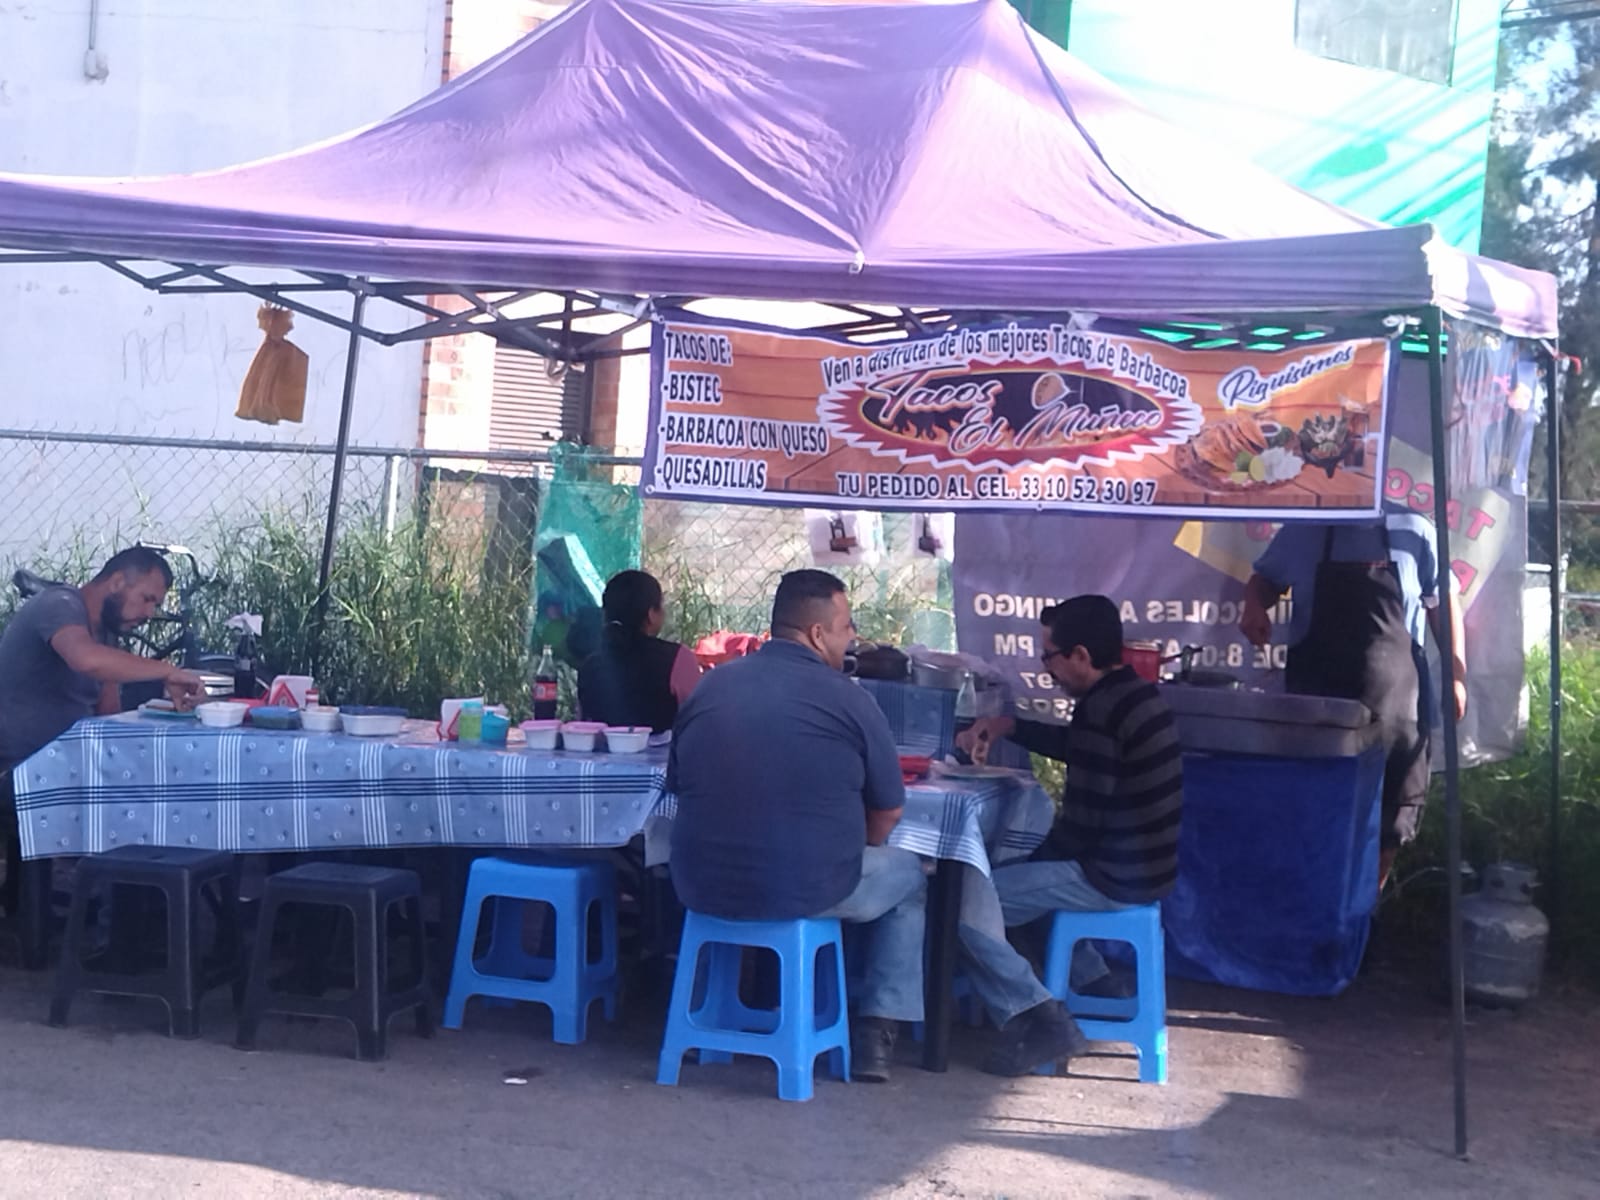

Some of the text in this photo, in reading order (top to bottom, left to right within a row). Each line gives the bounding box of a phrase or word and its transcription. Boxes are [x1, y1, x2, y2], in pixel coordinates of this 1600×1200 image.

[665, 331, 732, 365] TACOS DE:
[823, 324, 1187, 398] Ven a disfrutar de los mejores Tacos de Barbacoa
[866, 363, 1003, 423] Tacos
[666, 415, 828, 457] BARBACOA CON QUESO
[949, 401, 1163, 453] El Muñeco
[662, 456, 765, 490] QUESADILLAS
[837, 474, 1156, 503] TU PEDIDO AL CEL. 33 10 52 30 97
